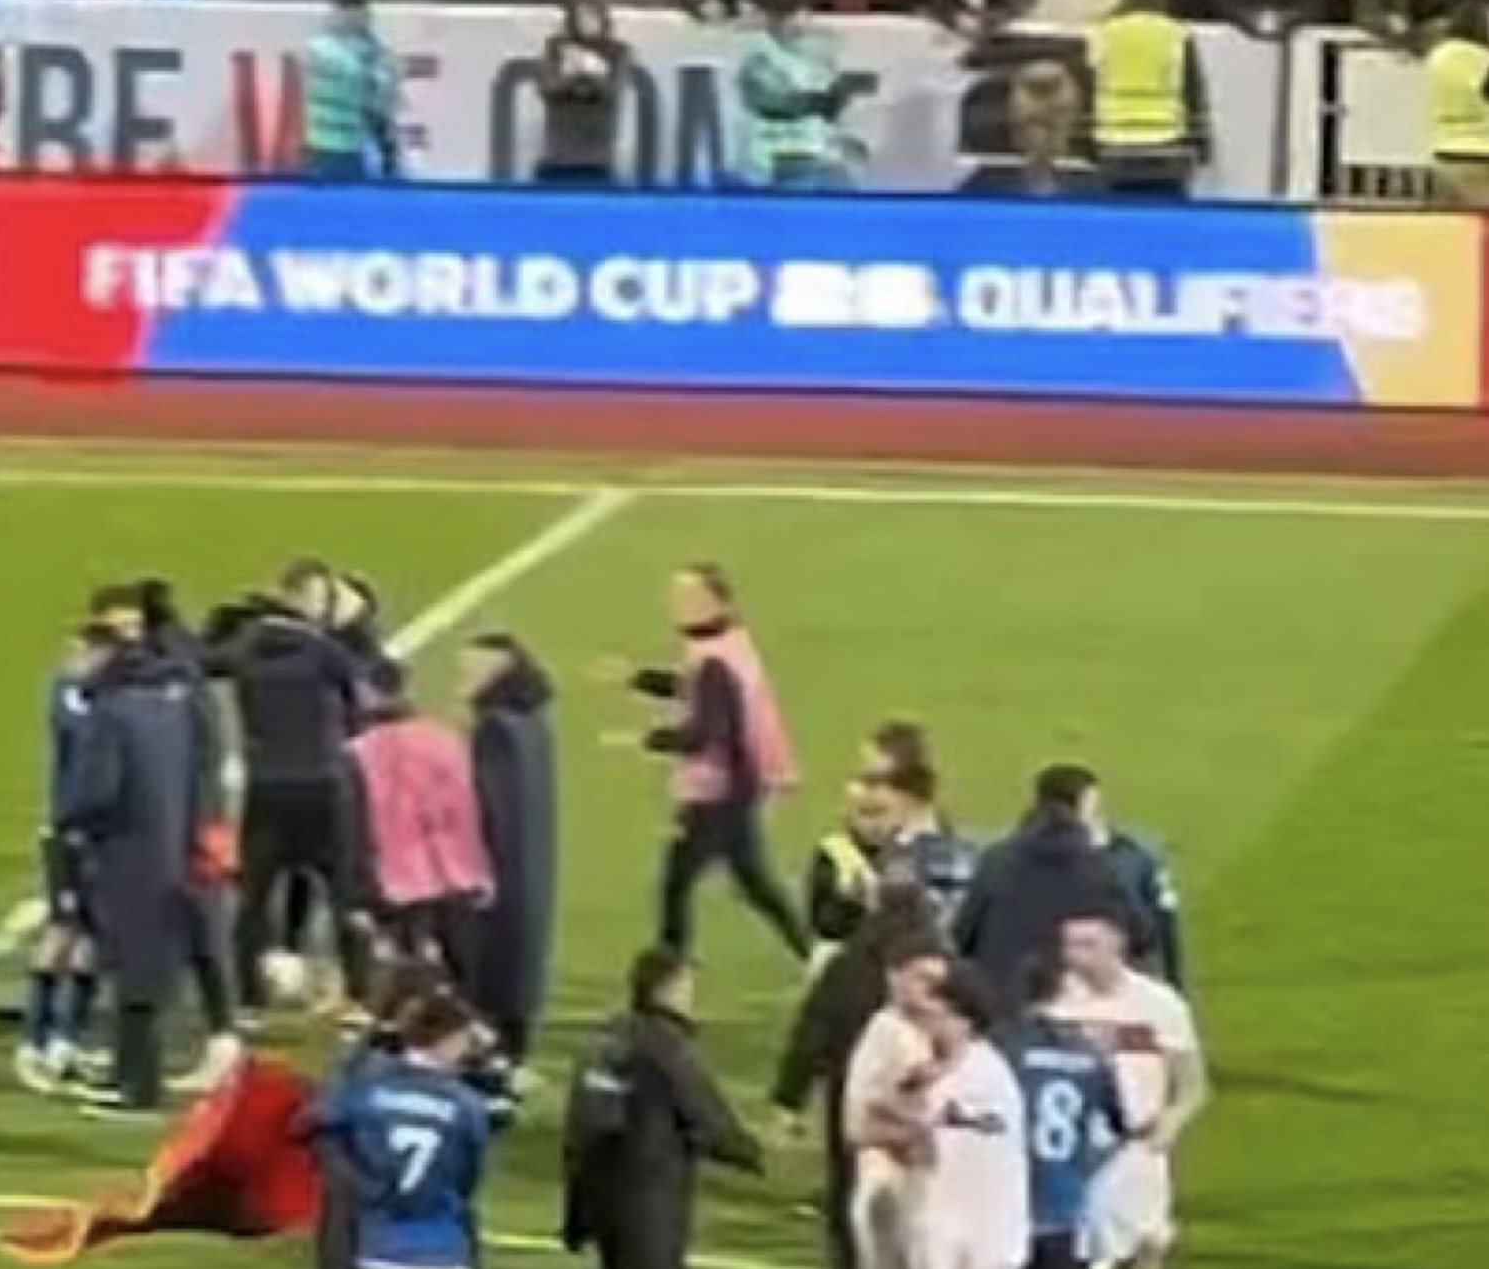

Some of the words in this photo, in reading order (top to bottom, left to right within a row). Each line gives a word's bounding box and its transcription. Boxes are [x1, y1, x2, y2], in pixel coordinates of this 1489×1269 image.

[84, 243, 264, 312] FIFA
[269, 248, 582, 320] WORLD
[587, 254, 761, 324] CUP
[956, 266, 1423, 341] QUALIFIERS
[387, 1126, 444, 1194] 7
[1035, 1079, 1083, 1162] 8
